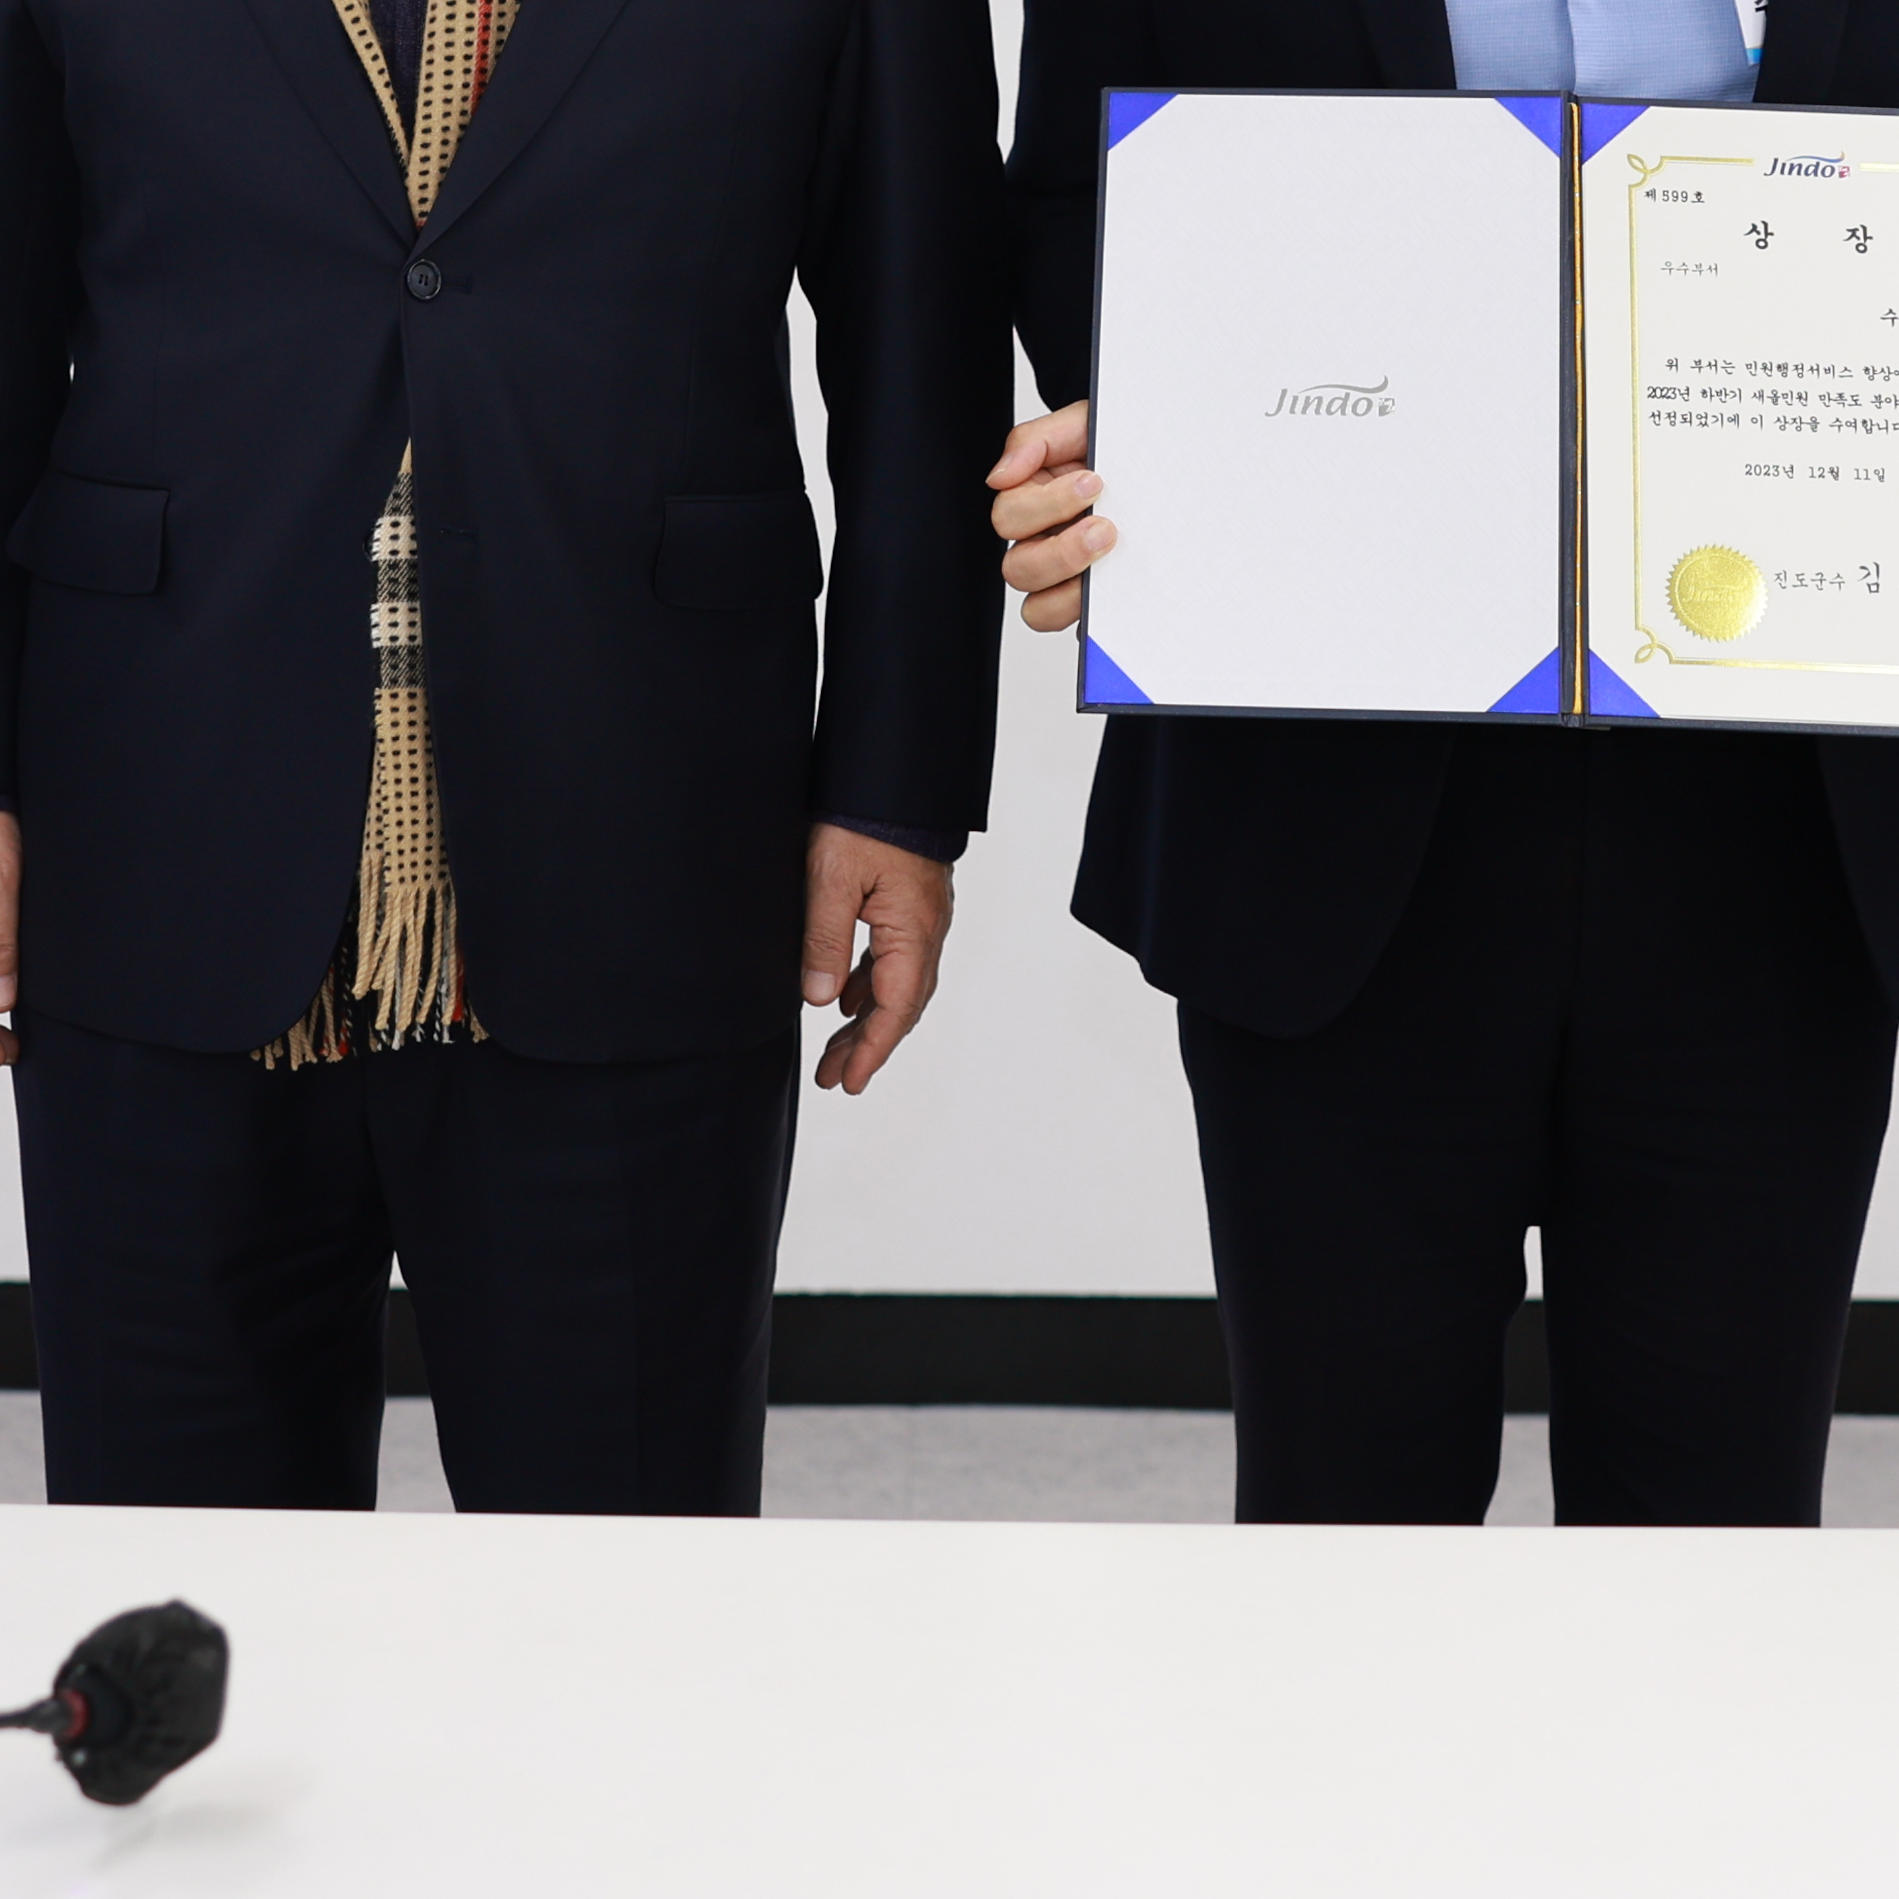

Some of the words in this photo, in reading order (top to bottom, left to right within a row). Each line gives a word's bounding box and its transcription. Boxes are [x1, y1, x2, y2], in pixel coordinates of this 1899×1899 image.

[1763, 157, 1836, 178] Jindo
[1743, 220, 1775, 250] 상
[1844, 223, 1874, 254] 장
[1660, 260, 1719, 278] 우수부서
[1665, 357, 1679, 373] 위
[1690, 358, 1736, 376] 부서는
[1745, 360, 1854, 380] 민원행정서비스
[1646, 385, 1691, 403] 2023년
[1700, 386, 1743, 404] 하반기
[1750, 388, 1809, 407] 새올민원
[1818, 391, 1863, 409] 만족도
[1648, 409, 1741, 430] 선정되었기에
[1750, 413, 1764, 431] 이
[1773, 414, 1821, 433] 상장을
[1744, 463, 1795, 480] 2023년
[1808, 466, 1840, 482] 12월
[1853, 467, 1886, 483] 11일
[1773, 569, 1846, 591] 진도군수
